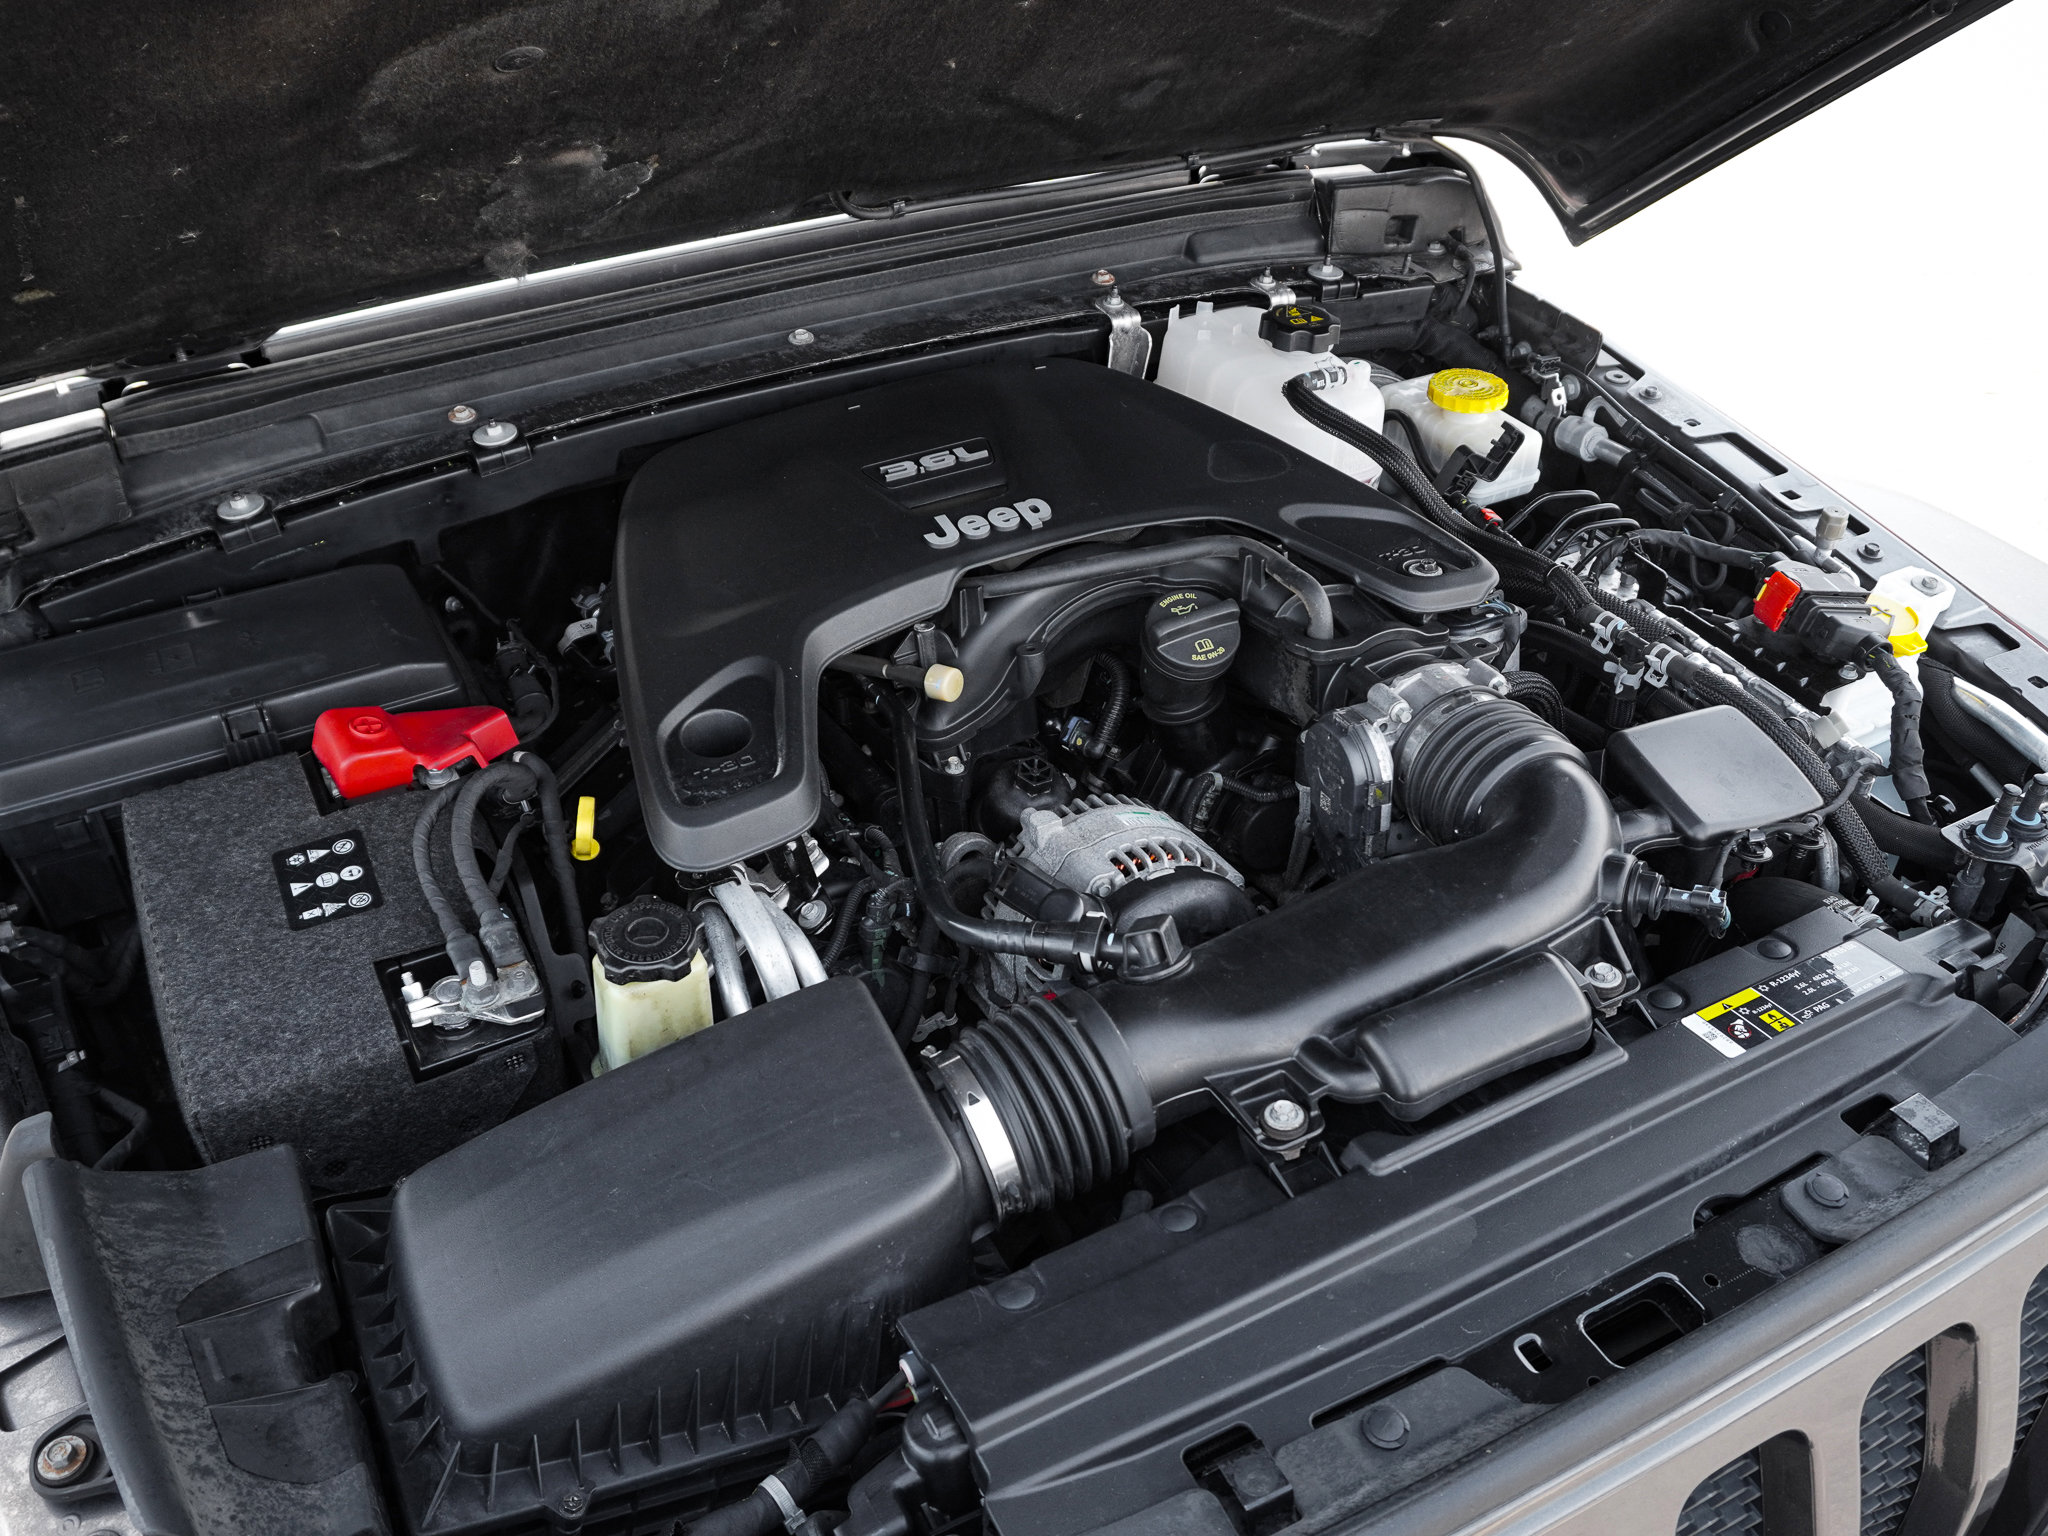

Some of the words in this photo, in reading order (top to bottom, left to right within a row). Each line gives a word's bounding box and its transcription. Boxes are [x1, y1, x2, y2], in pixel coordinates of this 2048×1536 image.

[879, 446, 989, 482] 3.6L
[923, 498, 1053, 549] Jeep
[1159, 593, 1184, 608] ENGINE
[1184, 592, 1198, 600] OIL
[622, 943, 679, 962] STEERING
[1769, 969, 1802, 987] R-1234yf
[1793, 981, 1809, 990] 3.6L
[1812, 1002, 1831, 1013] PAG
